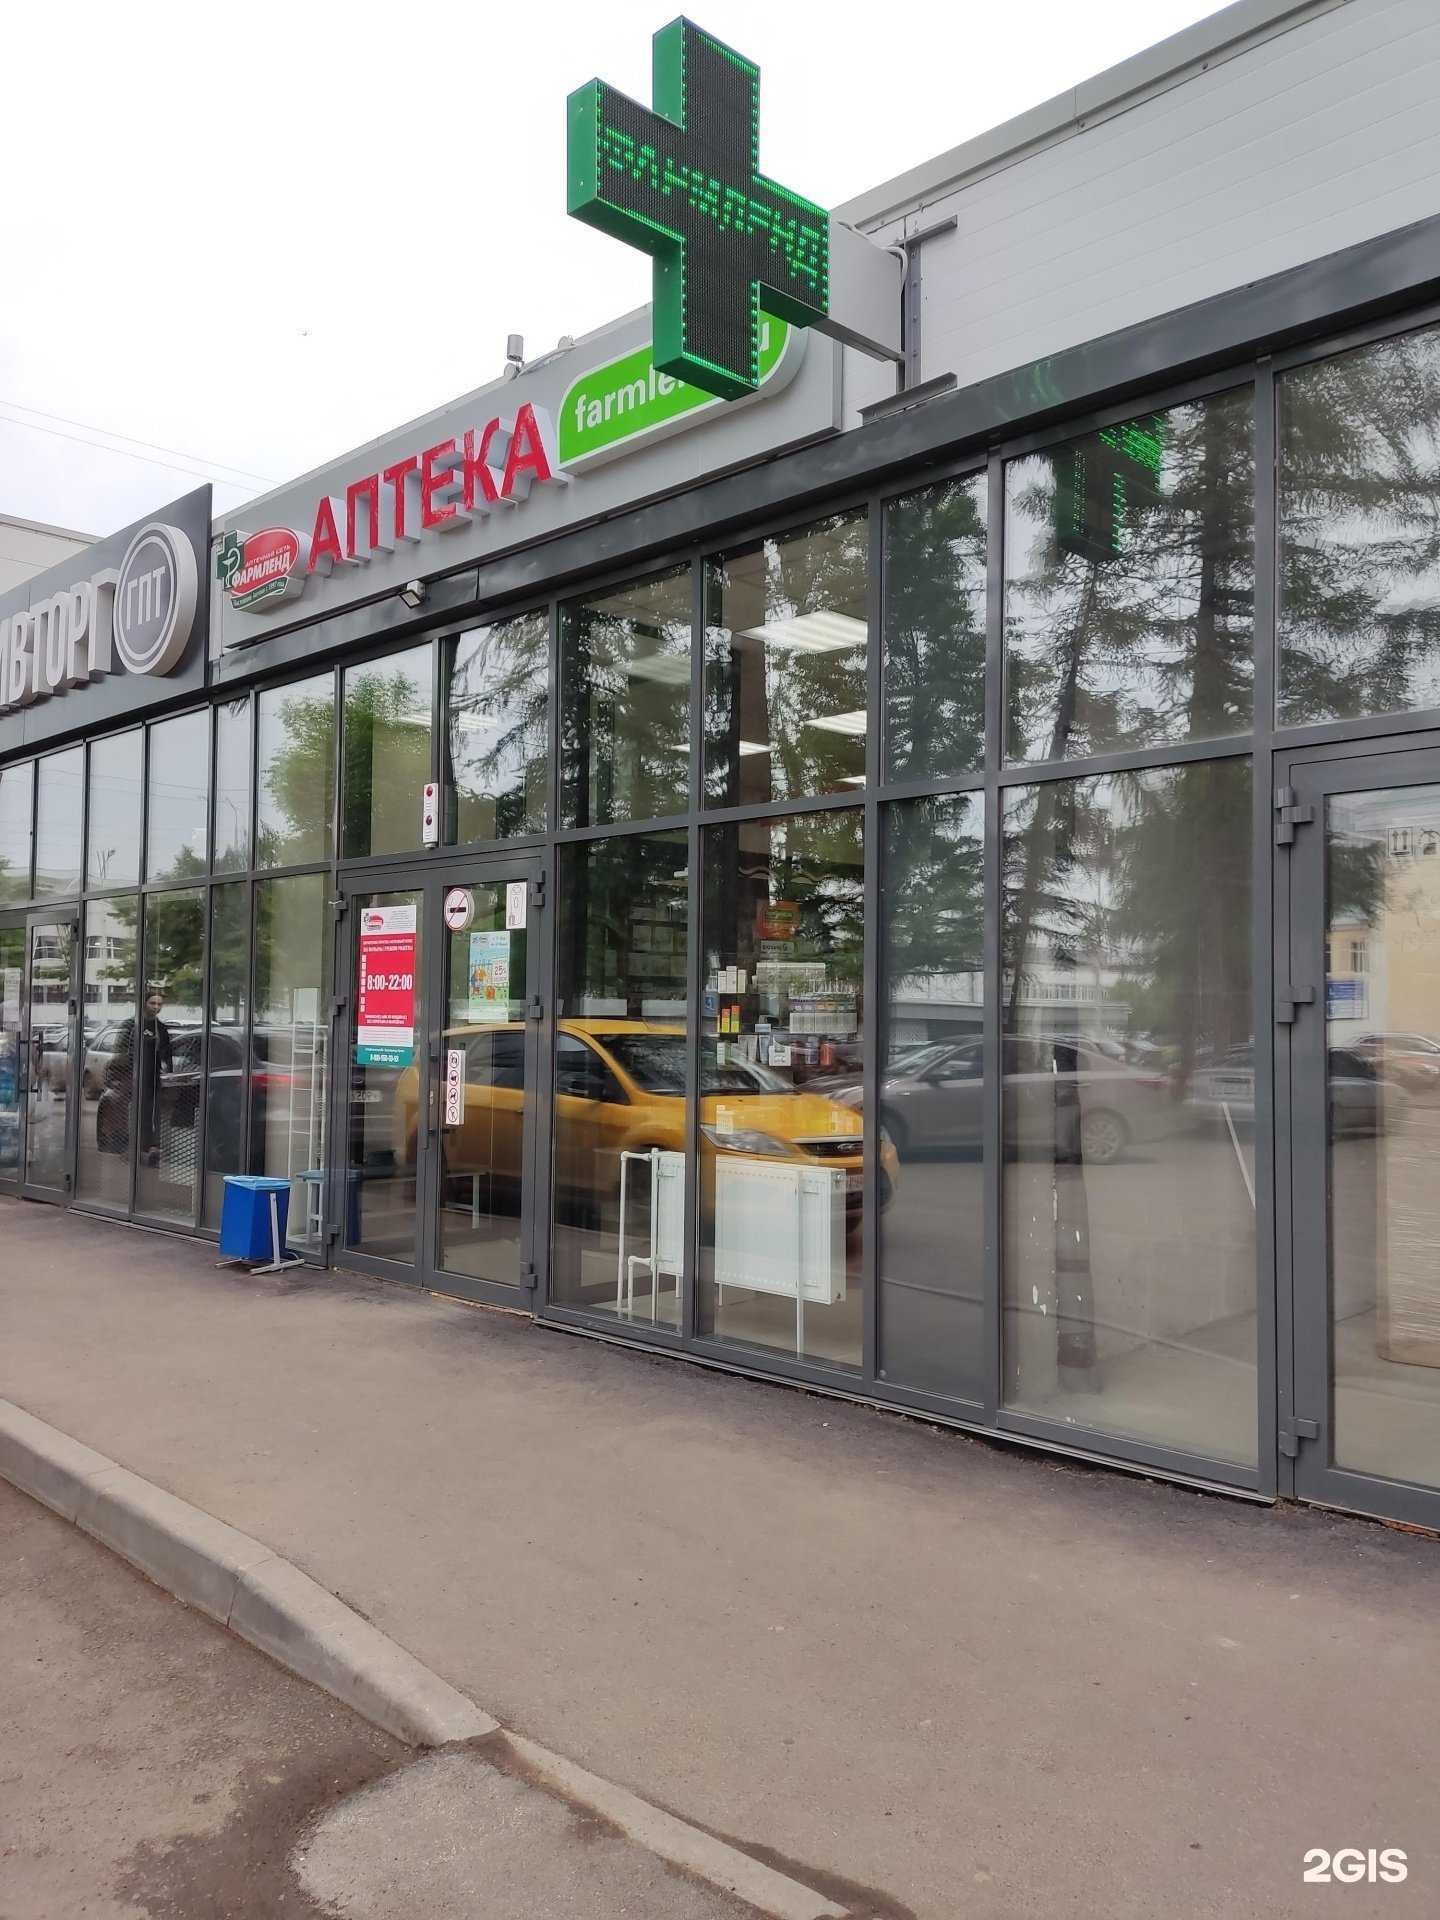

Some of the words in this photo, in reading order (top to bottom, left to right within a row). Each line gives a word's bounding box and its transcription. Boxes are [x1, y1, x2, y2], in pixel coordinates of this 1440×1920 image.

[307, 402, 555, 576] АПТЕКА
[231, 552, 291, 588] ФАРМЛЕНД
[126, 566, 166, 630] ГПТ
[367, 974, 413, 991] 8:00-22:00
